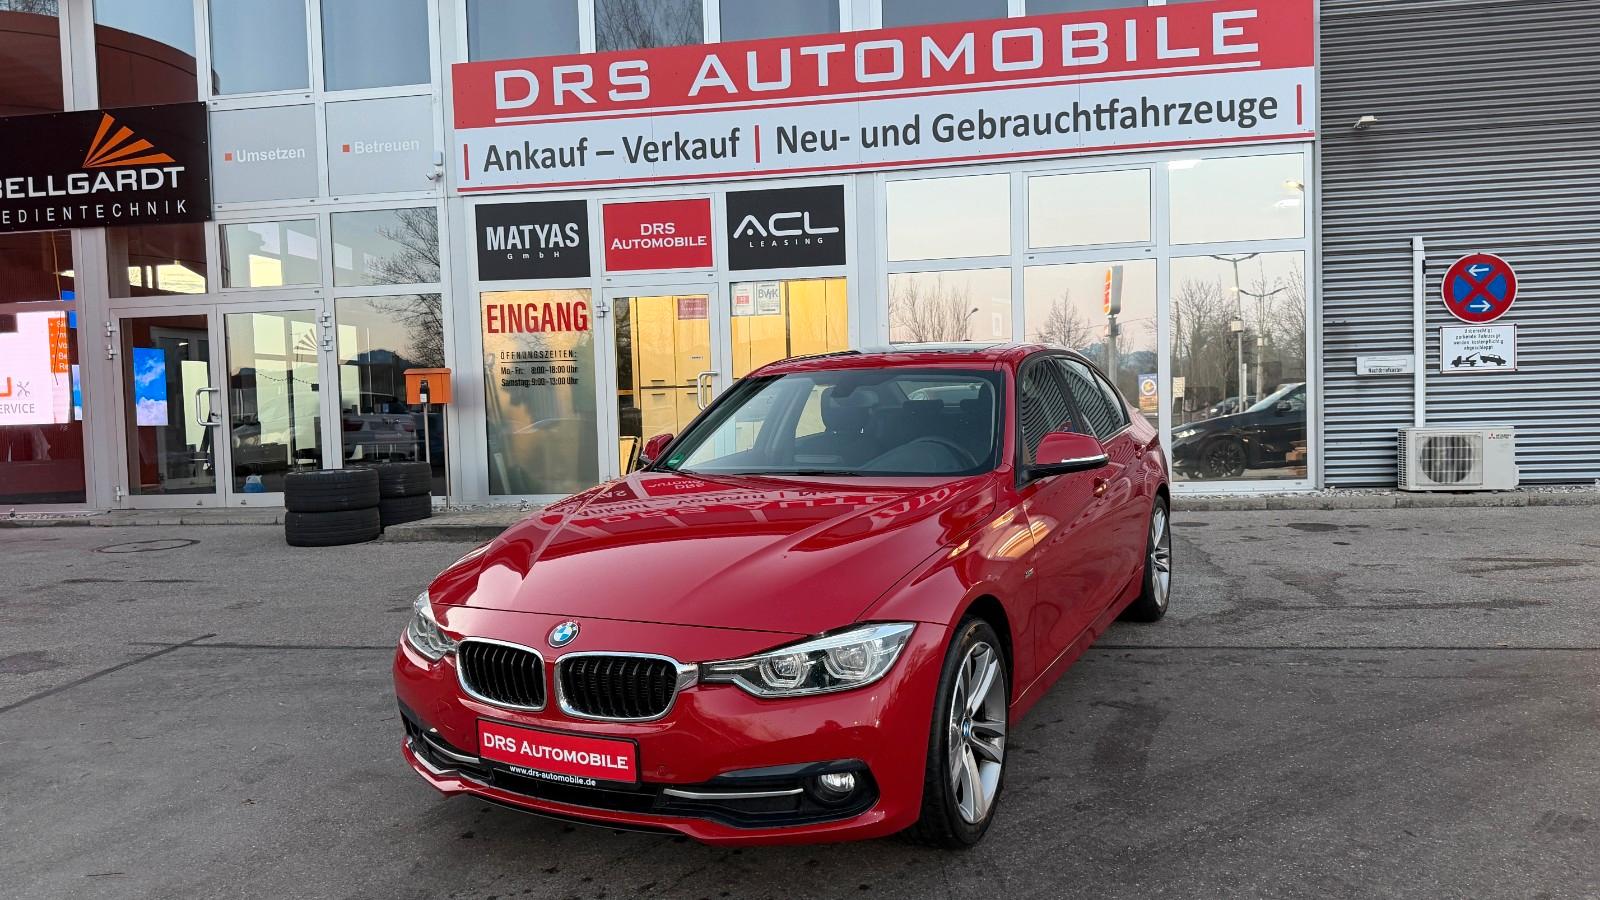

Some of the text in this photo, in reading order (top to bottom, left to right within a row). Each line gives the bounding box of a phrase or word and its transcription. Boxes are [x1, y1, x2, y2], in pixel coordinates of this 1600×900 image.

[494, 9, 1259, 110] DRS AUTOMOBILE
[483, 137, 588, 173] Ankauf
[622, 127, 741, 165] Verkauf
[776, 125, 851, 155] Neu-
[861, 116, 920, 149] und
[932, 95, 1279, 143] Gebrauchtfahrzeuge
[236, 147, 306, 163] Umsetzen
[354, 139, 420, 154] Betreuen
[0, 166, 185, 199] ELLGARDT
[486, 222, 580, 251] MATYAS
[640, 222, 676, 236] DRS
[733, 211, 840, 239] ACL
[611, 236, 708, 250] AUTOMOBILE
[749, 237, 824, 248] LEASING
[486, 301, 588, 334] EINGANG
[566, 364, 578, 374] Uhr
[566, 376, 579, 386] Uhr
[483, 732, 629, 770] DRS AUTOMOBILE
[509, 764, 597, 787] www.drs-automobile.de
